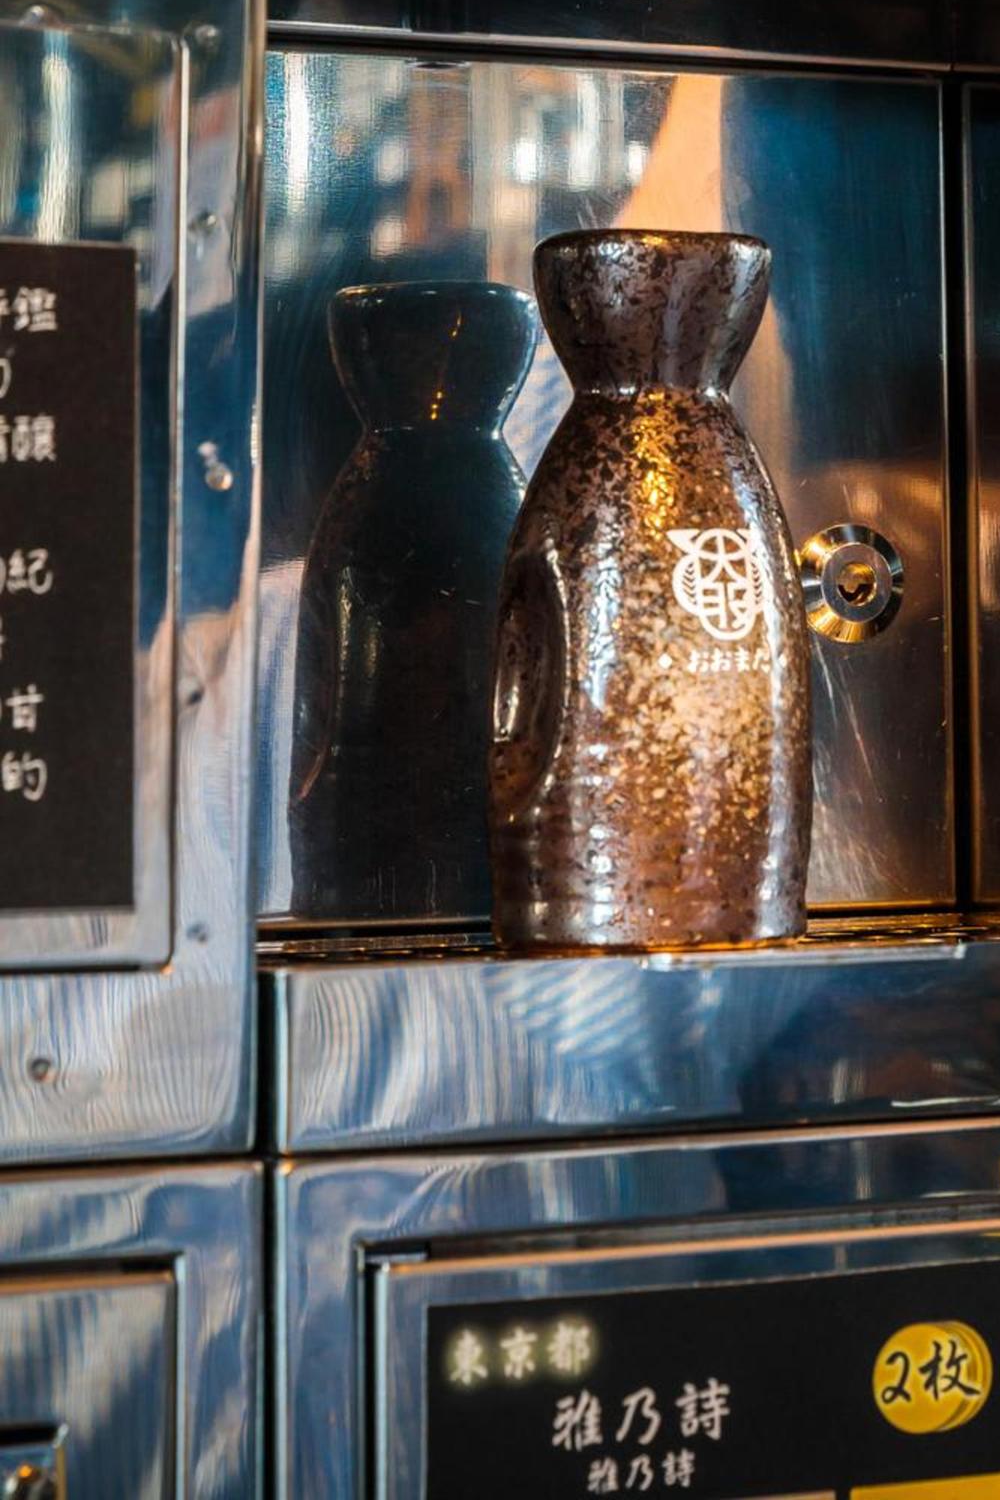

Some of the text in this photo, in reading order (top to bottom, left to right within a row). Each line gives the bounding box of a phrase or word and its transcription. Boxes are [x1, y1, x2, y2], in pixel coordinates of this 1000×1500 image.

[450, 1322, 592, 1385] 東京都
[881, 1338, 982, 1404] 2枚
[552, 1376, 731, 1452] 雅乃詩
[587, 1448, 696, 1496] 雅乃詩
